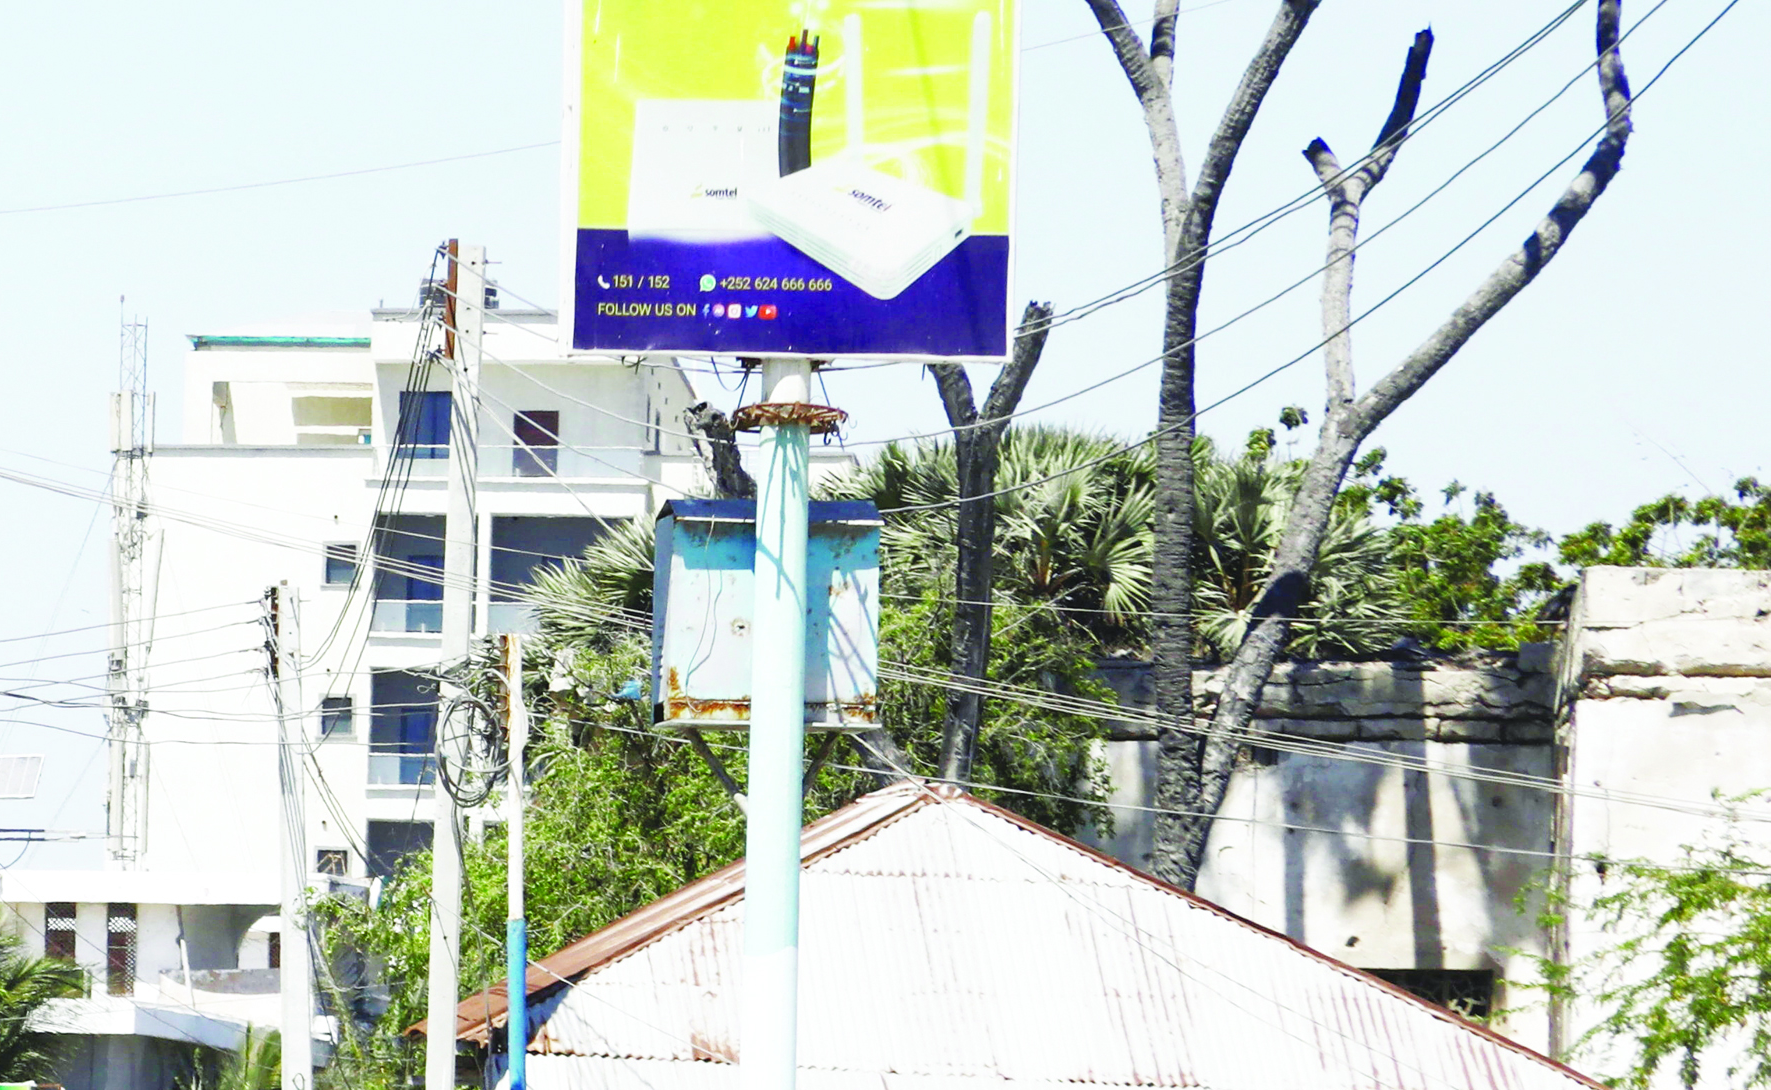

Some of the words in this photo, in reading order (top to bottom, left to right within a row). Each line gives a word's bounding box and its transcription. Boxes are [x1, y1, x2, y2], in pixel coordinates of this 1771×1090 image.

[705, 187, 738, 197] somtel
[848, 188, 892, 212] somtel
[612, 275, 633, 288] 151
[637, 276, 644, 288] /
[648, 275, 670, 289] 152
[720, 277, 751, 290] +252
[755, 277, 778, 290] 624
[782, 278, 805, 291] 666
[809, 278, 833, 292] 666
[598, 303, 651, 316] FOLLOW
[655, 303, 673, 316] US
[676, 303, 696, 316] ON
